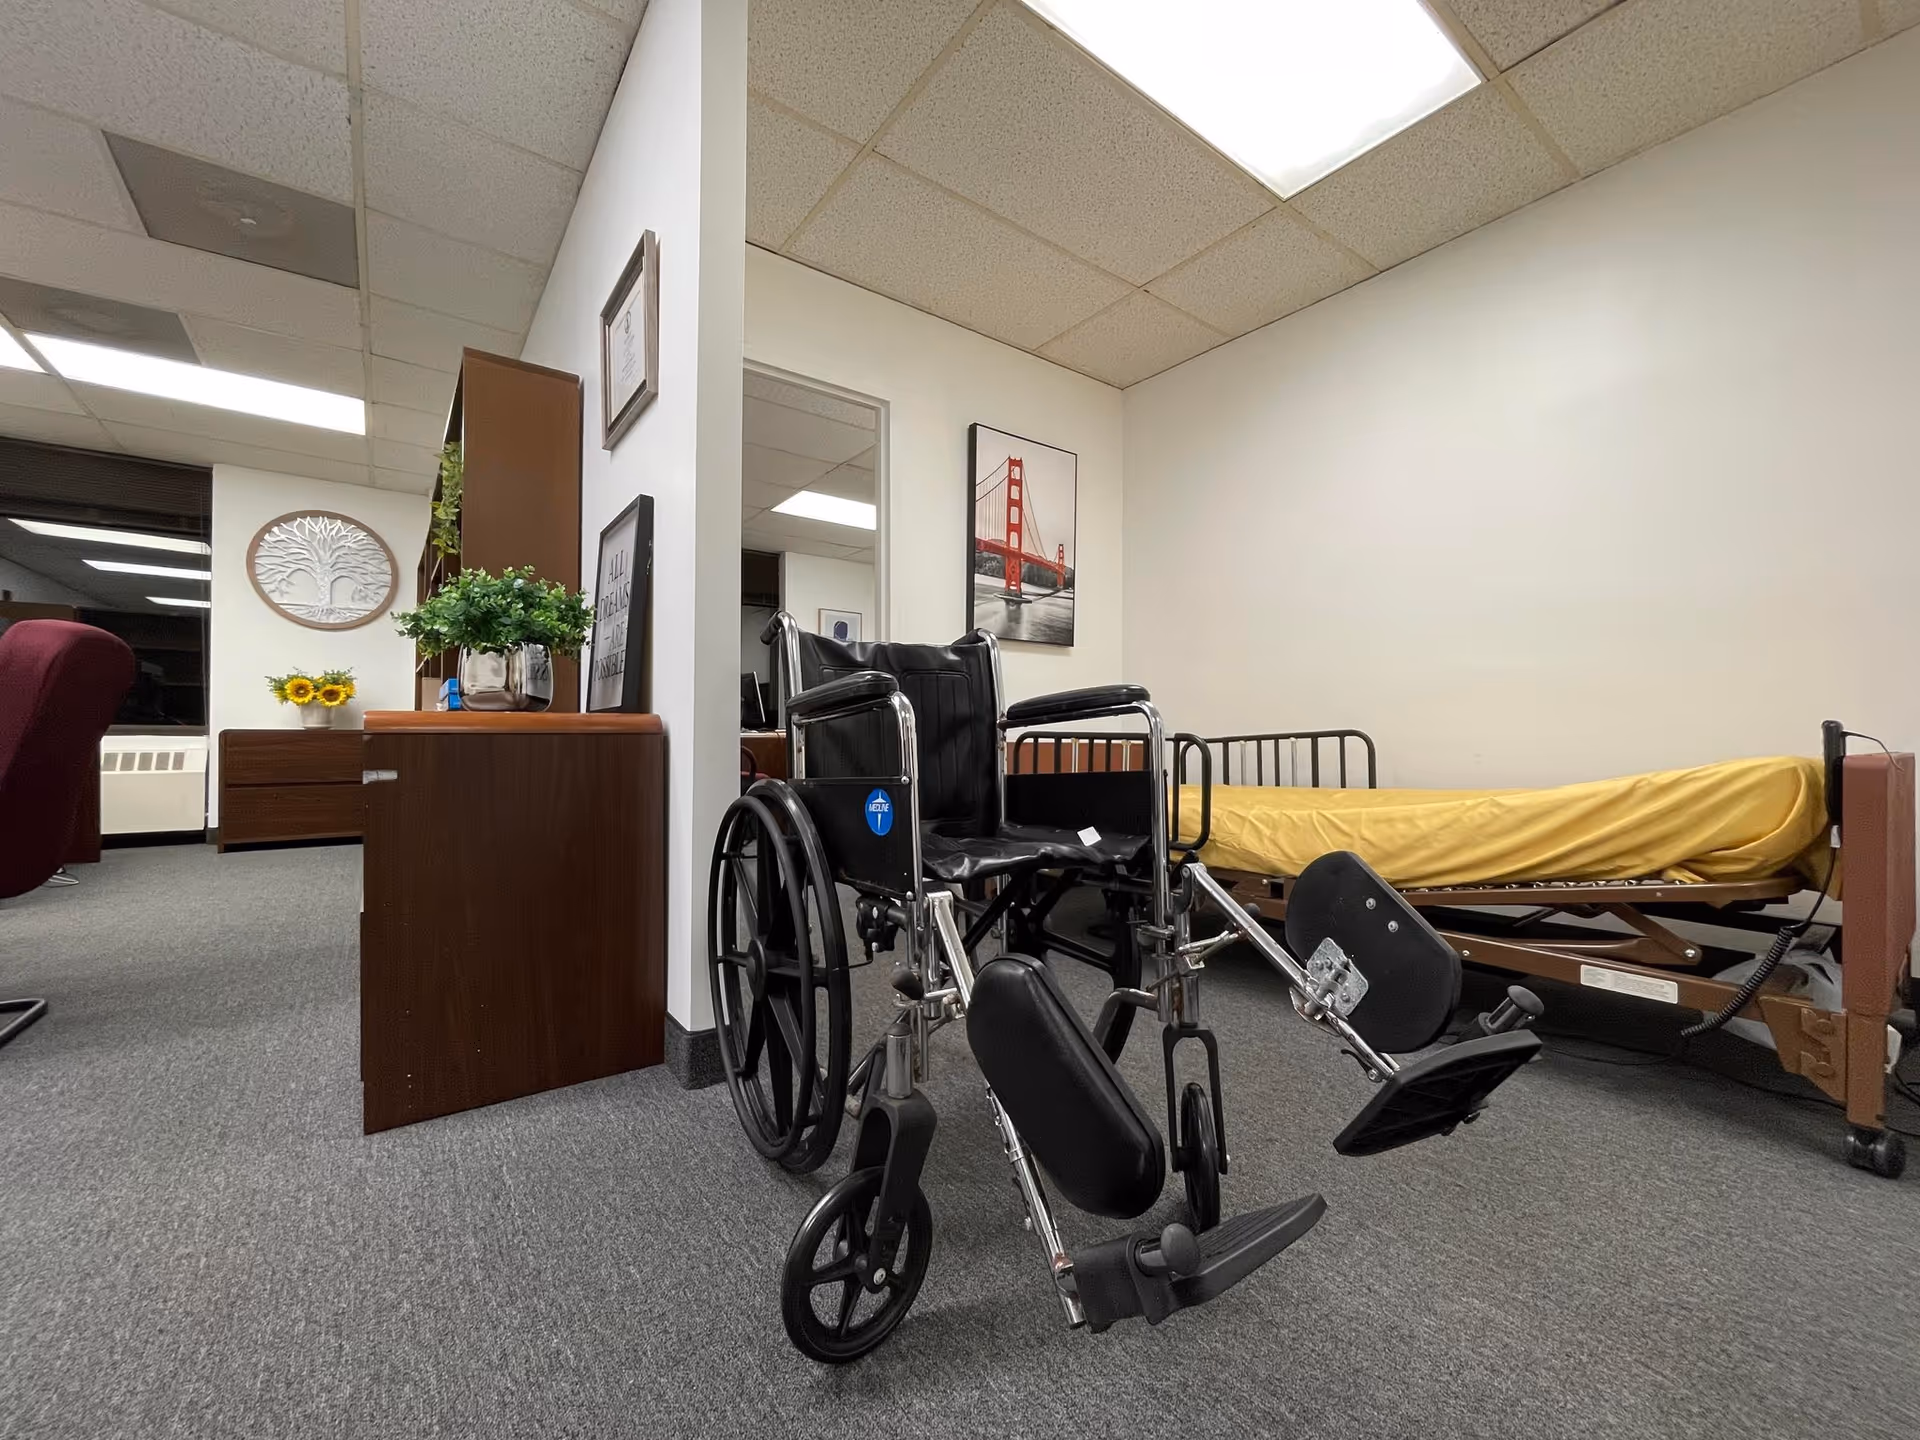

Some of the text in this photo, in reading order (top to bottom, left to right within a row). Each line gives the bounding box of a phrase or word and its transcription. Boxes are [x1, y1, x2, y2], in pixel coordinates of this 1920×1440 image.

[608, 550, 625, 584] ALL
[599, 581, 630, 622] DREAMS
[593, 650, 625, 682] POSSIBLE
[868, 803, 889, 812] MEDLINE
